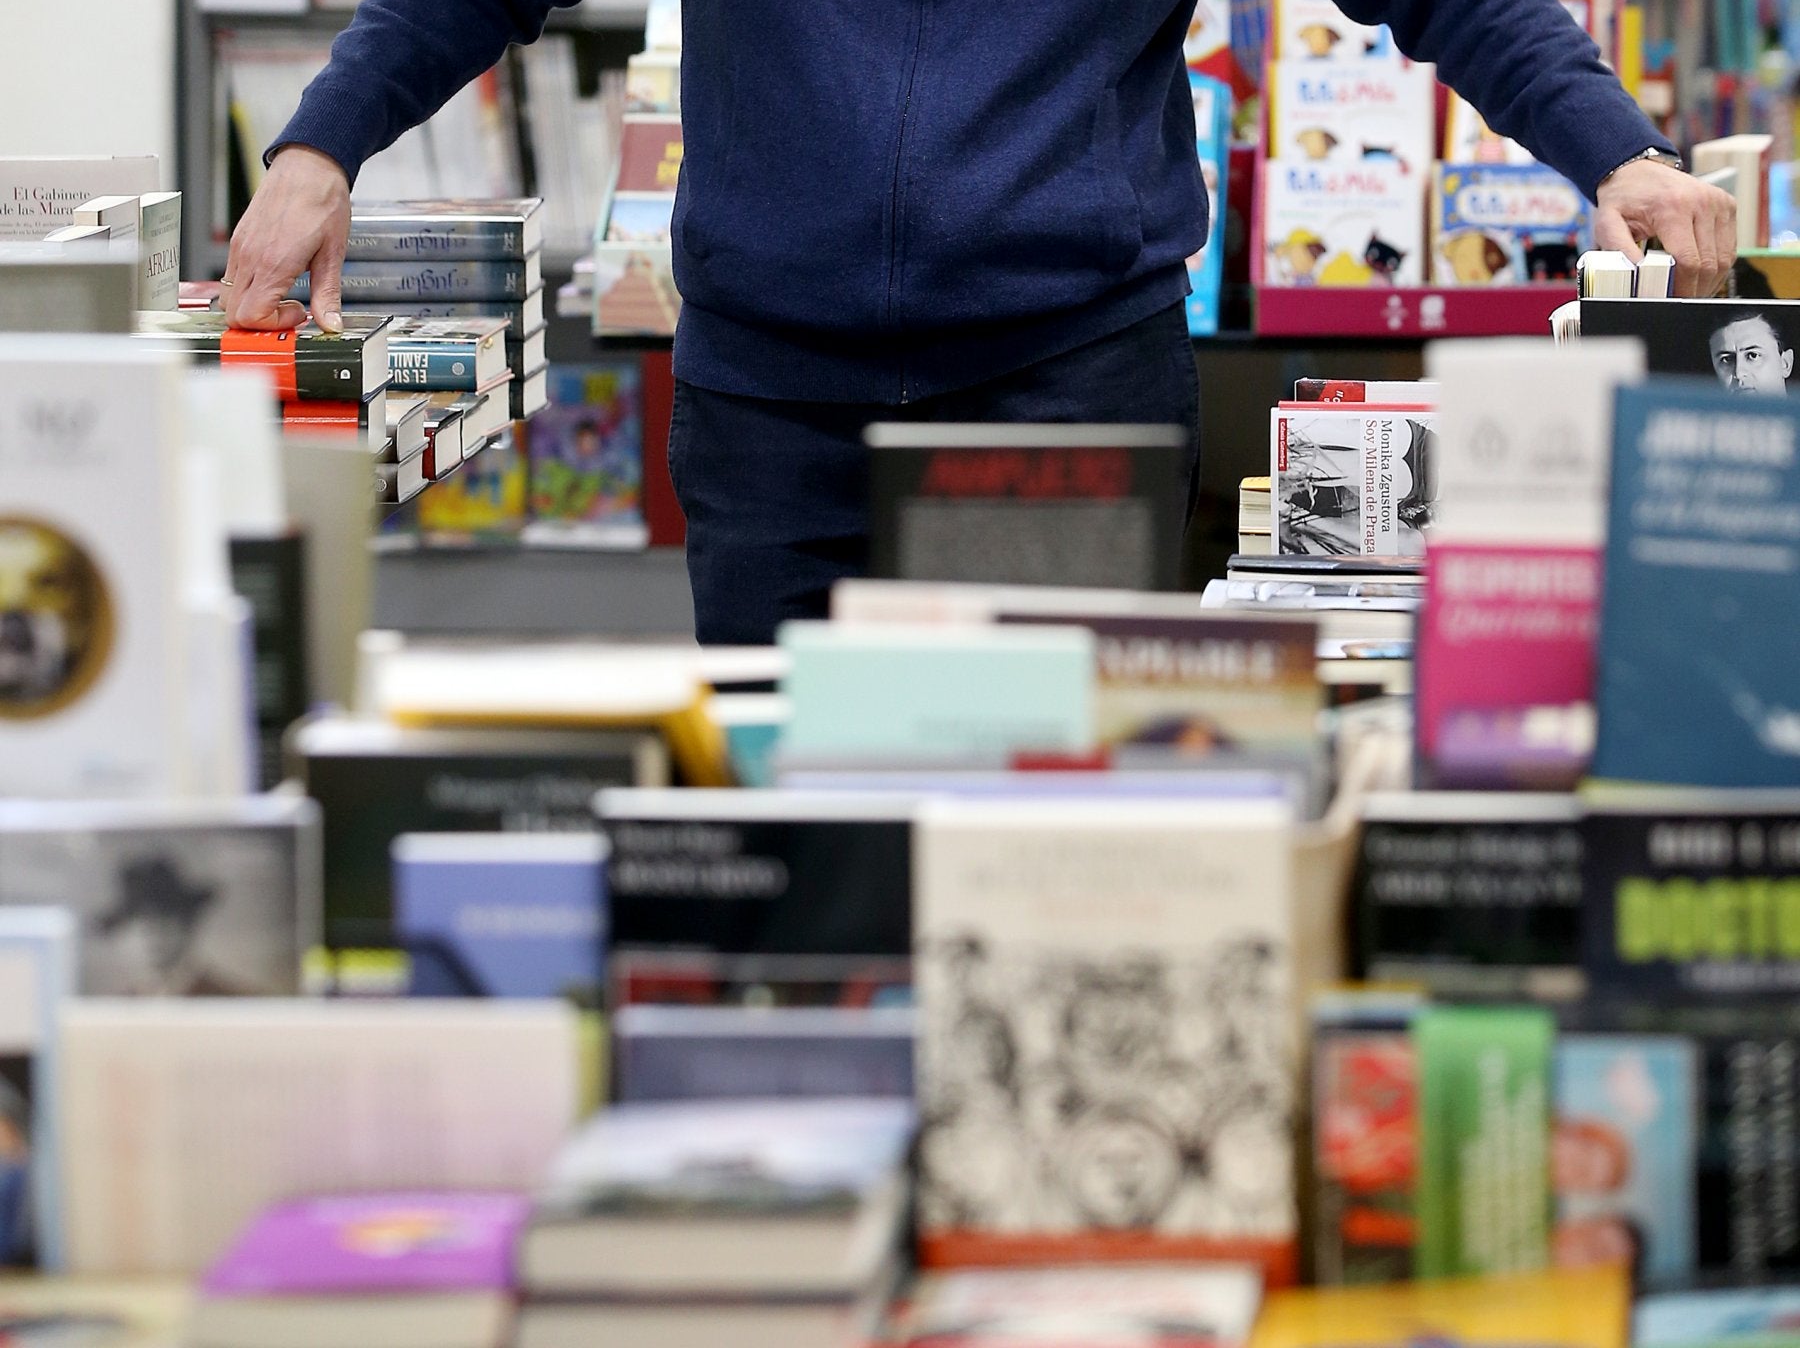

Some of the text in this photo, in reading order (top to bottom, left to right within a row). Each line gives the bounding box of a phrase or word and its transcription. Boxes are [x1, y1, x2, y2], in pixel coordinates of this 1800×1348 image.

[14, 186, 91, 200] El Gabinete
[18, 202, 35, 215] las
[39, 202, 75, 215] Mara
[411, 369, 427, 384] EL
[1378, 419, 1393, 532] Monika Zgustova
[1364, 419, 1378, 554] Soy Milena de Praga
